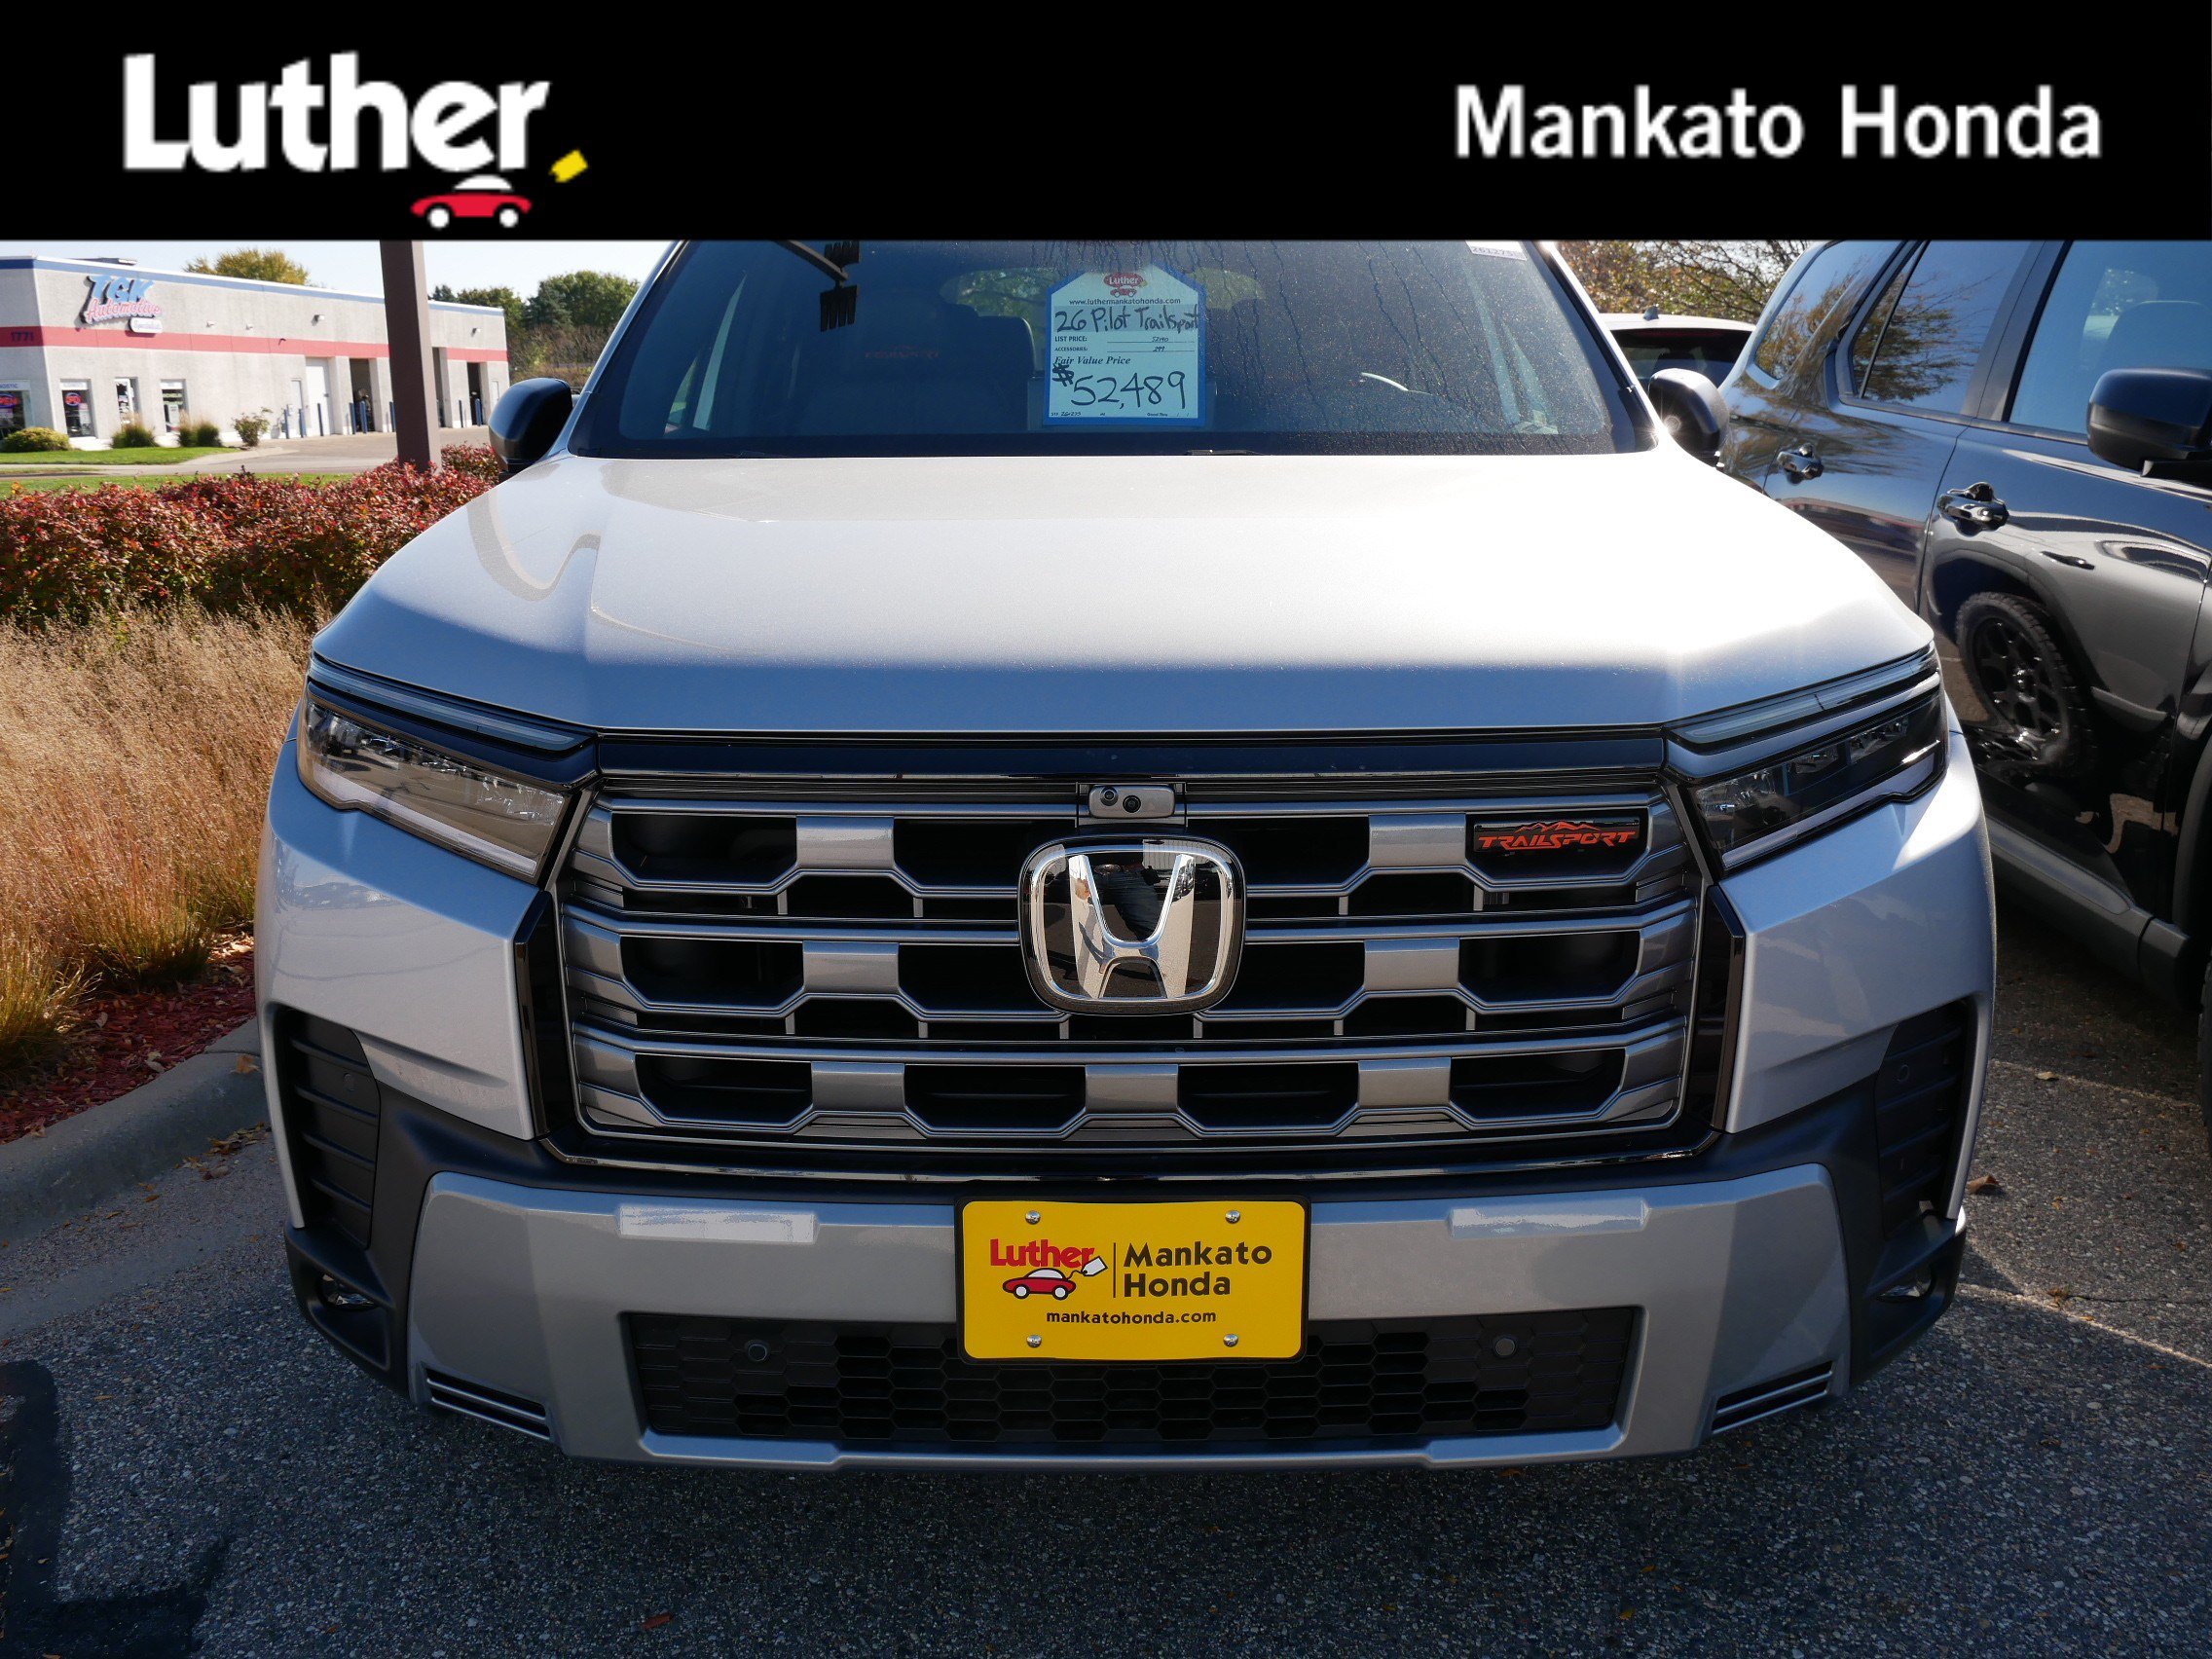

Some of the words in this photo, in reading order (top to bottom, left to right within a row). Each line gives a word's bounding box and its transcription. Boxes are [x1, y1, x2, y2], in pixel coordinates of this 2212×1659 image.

[88, 276, 154, 303] TGK
[1109, 276, 1139, 285] Luther
[86, 299, 162, 321] Automotive
[1069, 297, 1181, 306] www.luthermankatohonda.com
[1054, 309, 1088, 333] 26
[1090, 306, 1131, 333] Pilot
[11, 331, 35, 342] 1771
[1053, 356, 1074, 365] Fair
[1051, 364, 1186, 410] $52,489
[1478, 830, 1637, 851] TRAILSPORT
[989, 1238, 1095, 1269] Luther
[1123, 1240, 1272, 1269] Mankato
[1124, 1272, 1232, 1298] Honda
[1046, 1310, 1217, 1325] mankatohonda.com
